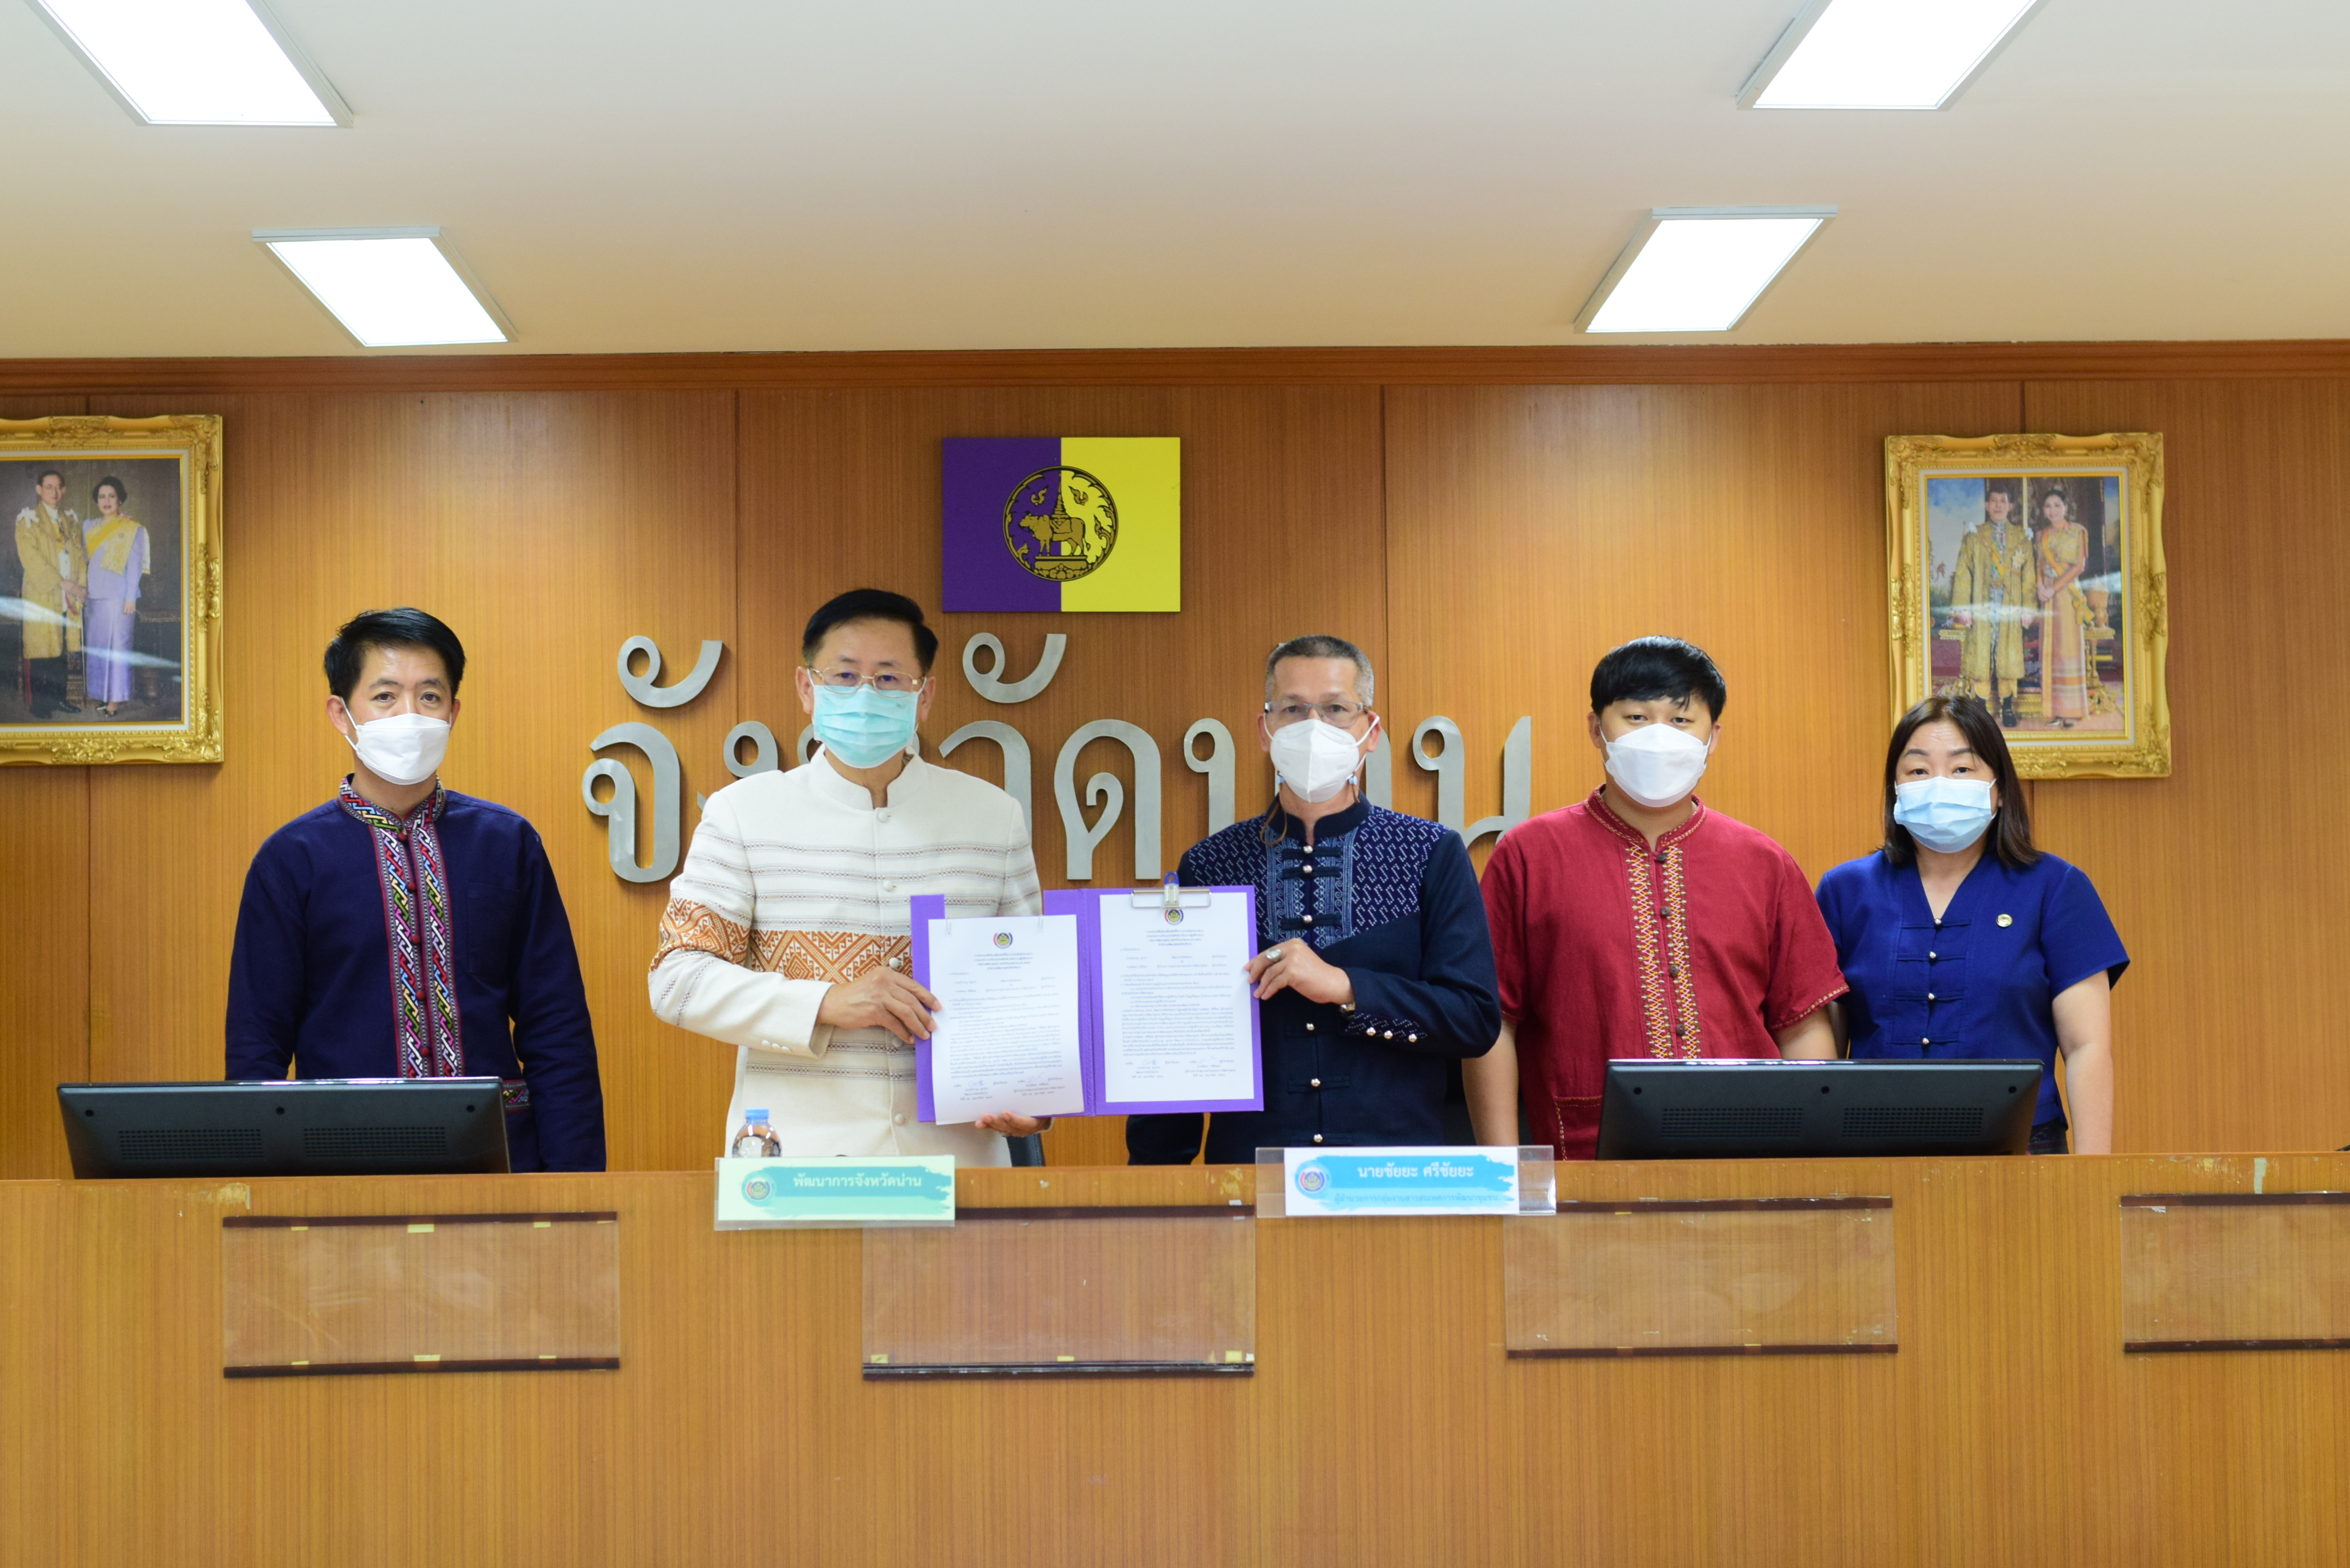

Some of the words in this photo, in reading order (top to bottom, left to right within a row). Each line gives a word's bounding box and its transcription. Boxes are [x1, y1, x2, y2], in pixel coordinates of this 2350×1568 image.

[1357, 1162, 1418, 1178] นายชัยยะ
[793, 1172, 923, 1187] พัฒนาการจังหวัดน่าน
